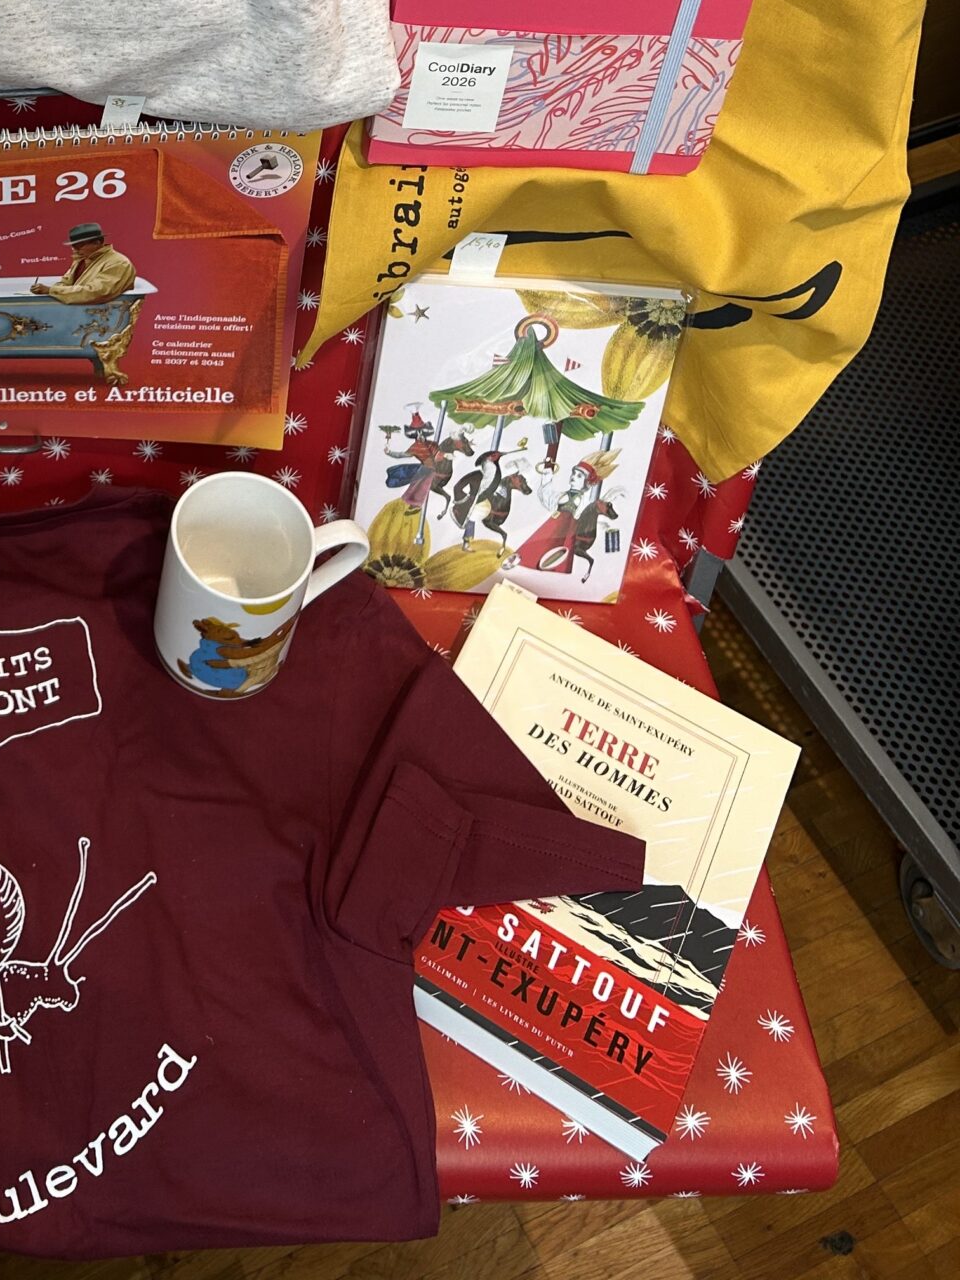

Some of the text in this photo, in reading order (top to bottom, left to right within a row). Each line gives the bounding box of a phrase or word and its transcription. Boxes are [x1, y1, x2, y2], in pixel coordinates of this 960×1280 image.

[428, 61, 496, 76] CoolDiary
[441, 76, 477, 87] 2026
[231, 147, 259, 173] PLONK
[278, 146, 302, 184] REPLONK
[55, 168, 127, 202] 26
[179, 314, 247, 324] l'indispensable
[151, 349, 208, 357] fonctionnera
[166, 340, 213, 348] calendrier
[74, 389, 97, 402] et
[104, 386, 235, 404] Arfiticielle
[549, 672, 696, 757] ANTOINE DE SAINT-EXUPÉRY
[560, 707, 660, 781] TERRE
[526, 723, 673, 813] DES HOMMES
[558, 774, 618, 812] ILLUSTRATIONS DE
[574, 795, 624, 827] SATTOUF
[493, 941, 540, 974] ILLUSTRE
[496, 913, 670, 1033] SATTOUF
[420, 955, 574, 1057] GALLIMARD LES LIVRES DU FUTUR
